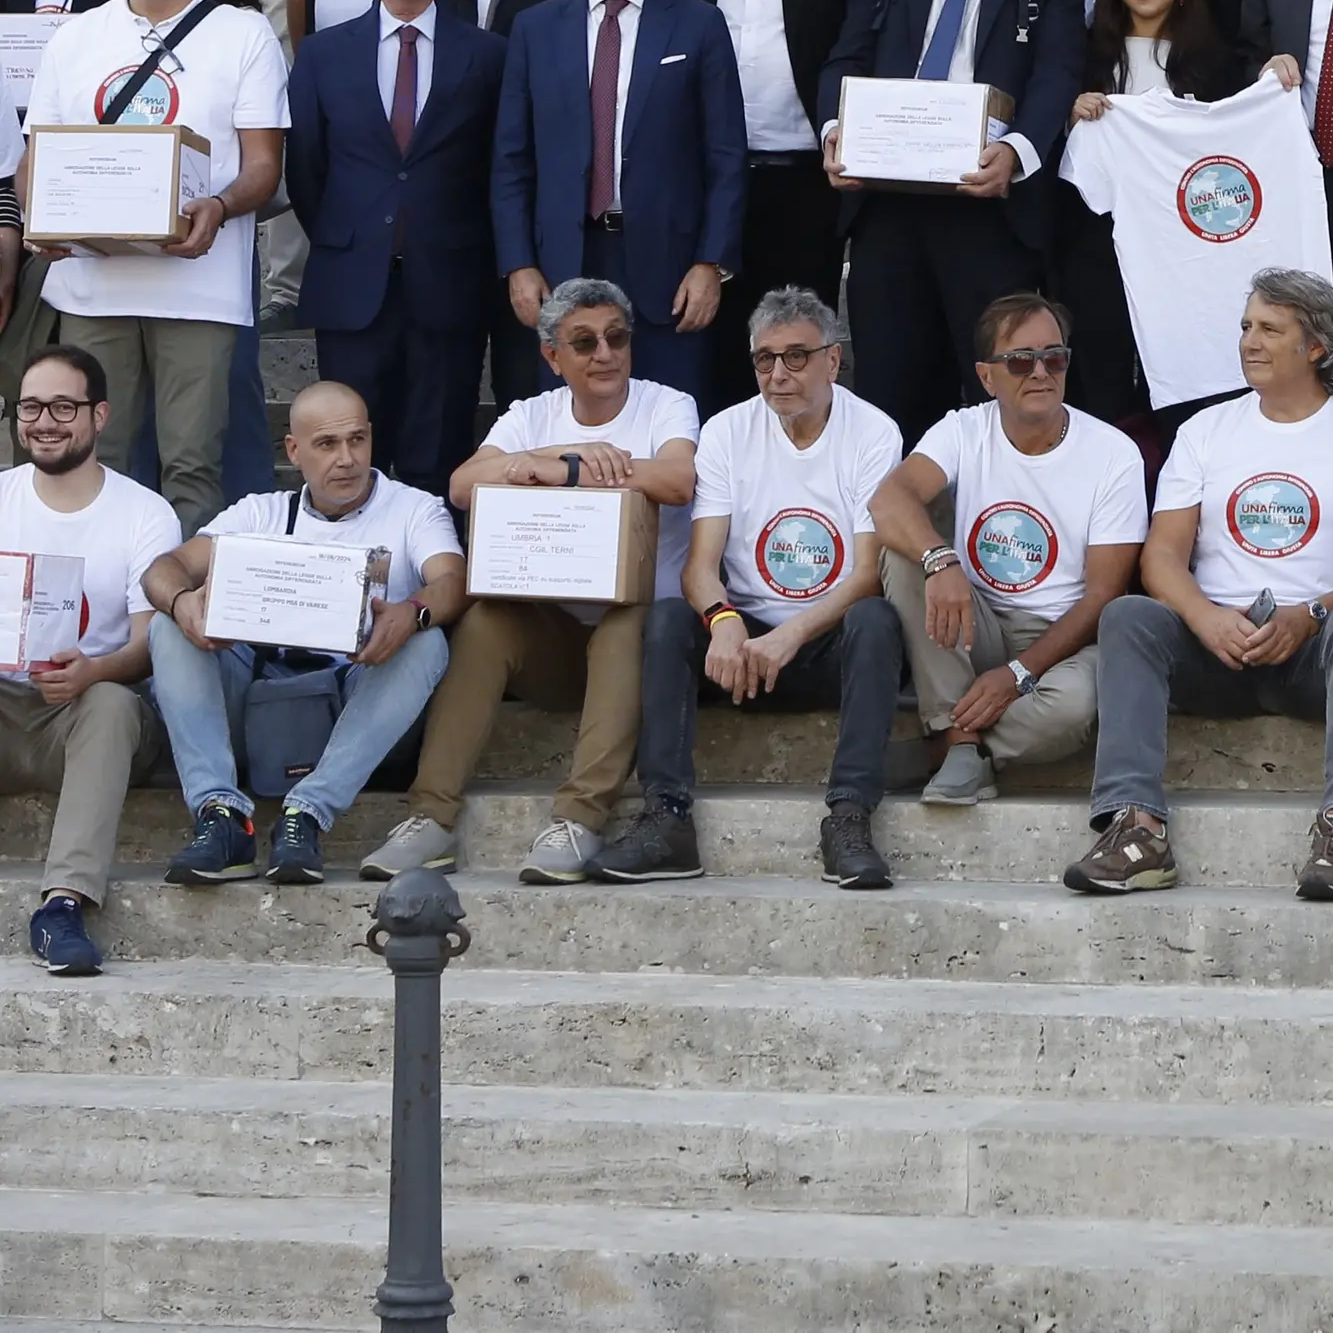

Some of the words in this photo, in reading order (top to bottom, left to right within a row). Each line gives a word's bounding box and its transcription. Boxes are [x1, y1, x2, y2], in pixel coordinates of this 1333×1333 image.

[1191, 204, 1210, 216] PER
[1240, 515, 1260, 524] PER
[529, 546, 548, 554] CGIL
[979, 541, 1000, 555] PER
[768, 552, 785, 563] PER
[263, 586, 297, 595] LOMBARDIA
[62, 600, 75, 610] 206
